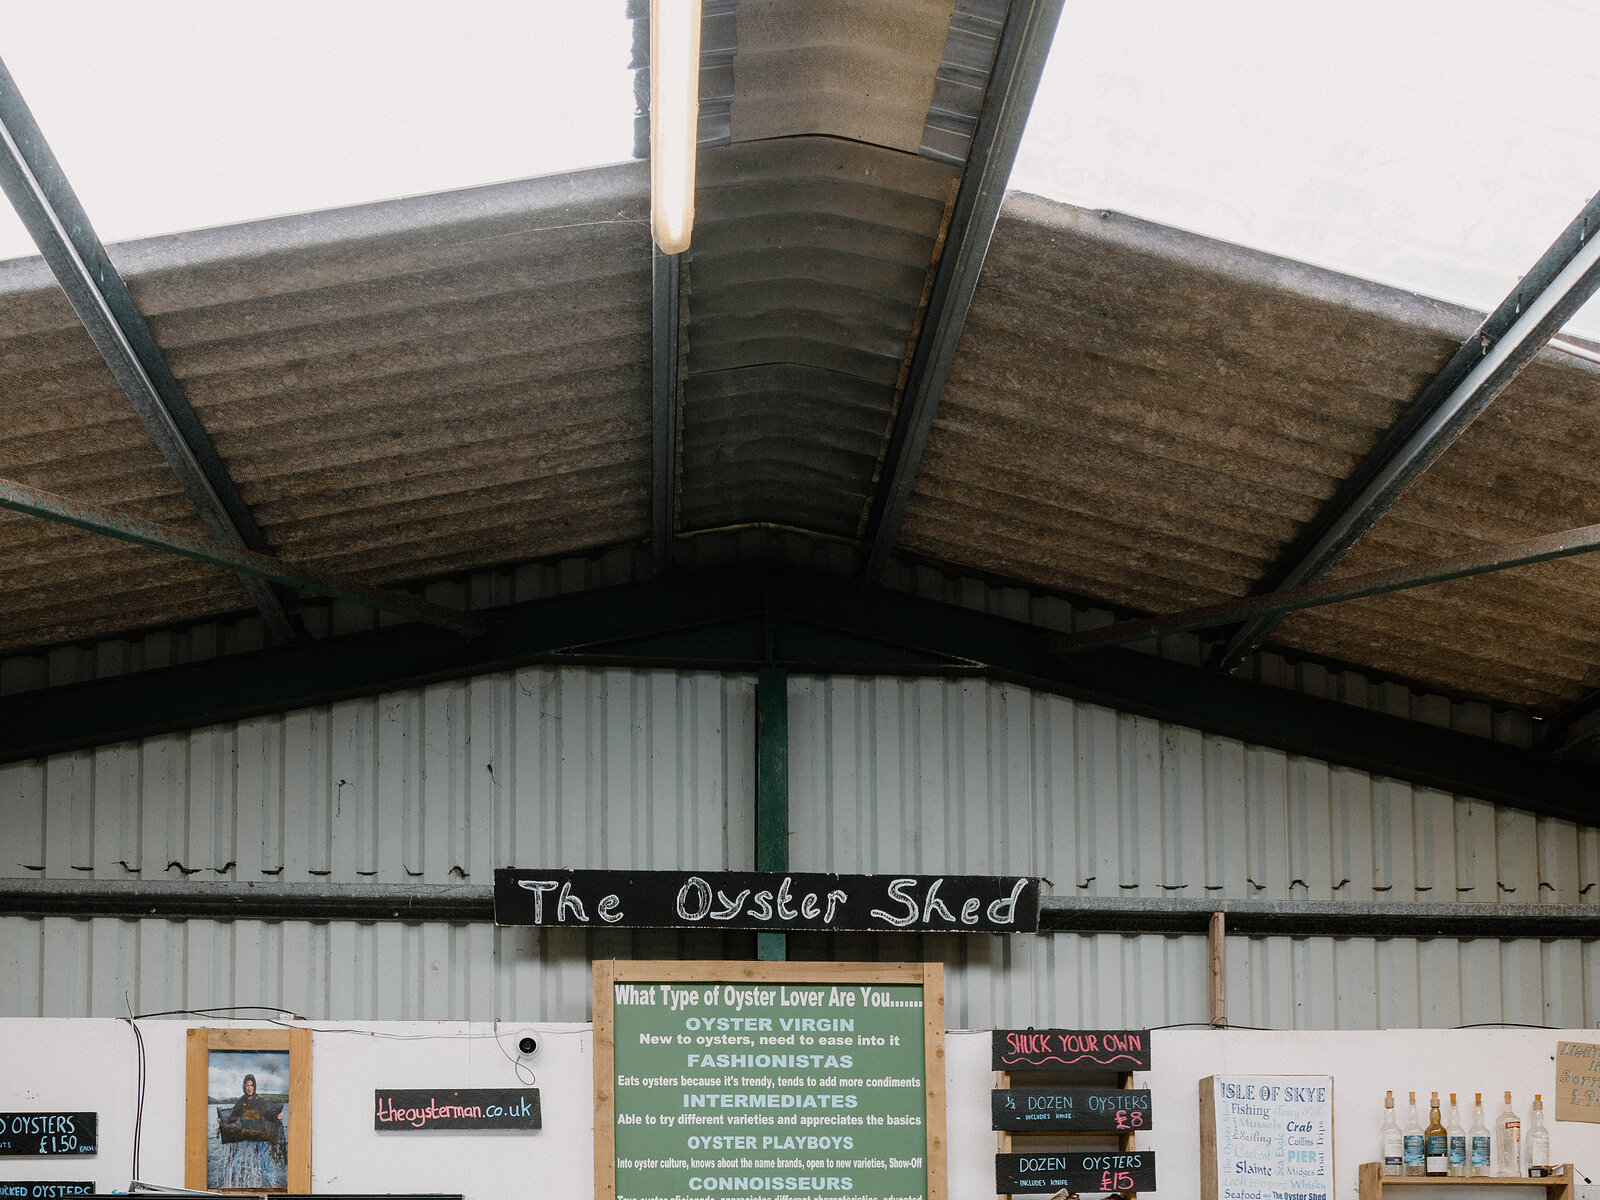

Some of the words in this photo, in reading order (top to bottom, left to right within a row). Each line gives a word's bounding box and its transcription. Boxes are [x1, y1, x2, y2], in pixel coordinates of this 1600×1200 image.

[517, 880, 624, 924] The
[676, 876, 848, 924] Oyster
[870, 878, 1028, 926] Shed
[614, 984, 656, 1006] What
[660, 985, 699, 1011] Type
[703, 985, 720, 1006] of
[724, 985, 776, 1012] Oyster
[780, 986, 825, 1007] Lover
[828, 986, 856, 1007] Are
[685, 1017, 773, 1031] OYSTER
[778, 1017, 855, 1032] VIRGIN
[639, 1033, 673, 1045] New
[677, 1034, 691, 1045] to
[696, 1034, 755, 1047] oysters,
[759, 1034, 795, 1045] need
[800, 1034, 814, 1045] to
[818, 1036, 853, 1046] ease
[857, 1035, 885, 1046] into
[889, 1035, 900, 1046] it
[1006, 1033, 1052, 1055] SHUCK
[1058, 1034, 1099, 1052] YOUR
[1103, 1034, 1142, 1052] OWN
[687, 1054, 854, 1068] FASHIONISTAS
[617, 1075, 640, 1087] Eats
[642, 1076, 678, 1088] oysters
[681, 1075, 722, 1087] because
[724, 1075, 739, 1087] it's
[741, 1076, 775, 1089] trendy,
[777, 1076, 804, 1087] tends
[807, 1077, 817, 1087] to
[819, 1076, 836, 1087] add
[839, 1078, 863, 1087] more
[866, 1076, 921, 1088] condiments
[1220, 1083, 1255, 1100] ISLE
[1260, 1085, 1281, 1102] OF
[1284, 1086, 1326, 1103] SKYE
[683, 1094, 858, 1108] INTERMEDIATES
[1027, 1096, 1073, 1110] DOZEN
[1088, 1095, 1149, 1111] OYSTERS
[376, 1096, 532, 1127] theoysterman.co.uk
[1230, 1102, 1271, 1120] Fishing
[11, 1115, 76, 1134] OYSTERS
[617, 1114, 643, 1125] Able
[645, 1115, 656, 1125] to
[659, 1115, 675, 1127] try
[677, 1114, 724, 1125] different
[727, 1114, 774, 1125] varieties
[777, 1114, 797, 1125] and
[800, 1114, 864, 1127] appreciates
[866, 1115, 884, 1125] the
[886, 1115, 921, 1125] basics
[1114, 1110, 1143, 1129] £8
[1239, 1118, 1282, 1129] Mussels
[1286, 1120, 1313, 1133] Crab
[1240, 1130, 1272, 1147] Sailing
[1317, 1120, 1325, 1148] Trips
[39, 1135, 77, 1154] £1.50
[687, 1136, 757, 1150] OYSTER
[762, 1136, 854, 1150] PLAYBOYS
[1287, 1136, 1314, 1147] Cuillins
[1287, 1150, 1317, 1163] PIER
[617, 1158, 633, 1169] Into
[634, 1158, 658, 1171] oyster
[660, 1158, 689, 1170] culture,
[691, 1158, 715, 1168] knows
[717, 1158, 739, 1168] about
[740, 1158, 753, 1168] the
[754, 1160, 775, 1168] name
[777, 1158, 805, 1170] brands,
[806, 1160, 824, 1171] open
[826, 1158, 834, 1168] to
[836, 1160, 852, 1168] new
[853, 1158, 887, 1170] varieties,
[889, 1157, 923, 1168] Show-Off
[1019, 1157, 1066, 1173] DOZEN
[1082, 1155, 1142, 1170] OYSTERS
[1274, 1160, 1285, 1177] Sea
[1286, 1166, 1315, 1178] Midges
[688, 1177, 853, 1191] CONNOISSEURS
[1020, 1179, 1046, 1187] INCLUDES
[1100, 1171, 1134, 1191] £15
[1289, 1179, 1327, 1191] Whisky
[1224, 1188, 1261, 1200] Seafood
[1272, 1190, 1283, 1200] The
[1284, 1192, 1307, 1200] Oyster
[1308, 1192, 1327, 1200] Shed
